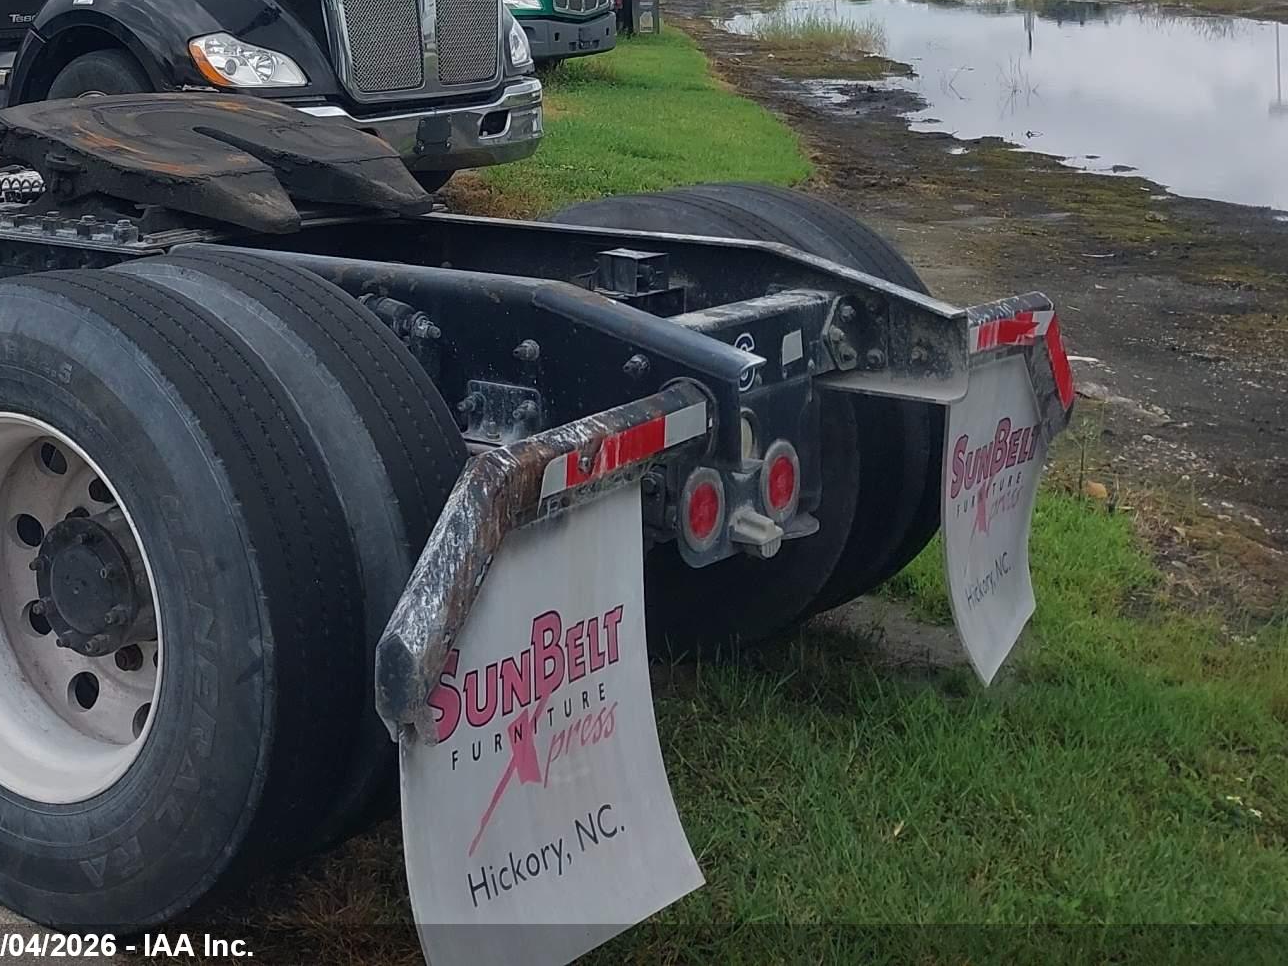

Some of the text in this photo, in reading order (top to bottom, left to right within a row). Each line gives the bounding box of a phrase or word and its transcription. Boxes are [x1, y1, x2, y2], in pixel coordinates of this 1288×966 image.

[450, 682, 607, 771] FURNITURE
[467, 804, 626, 908] Hickory, NC.
